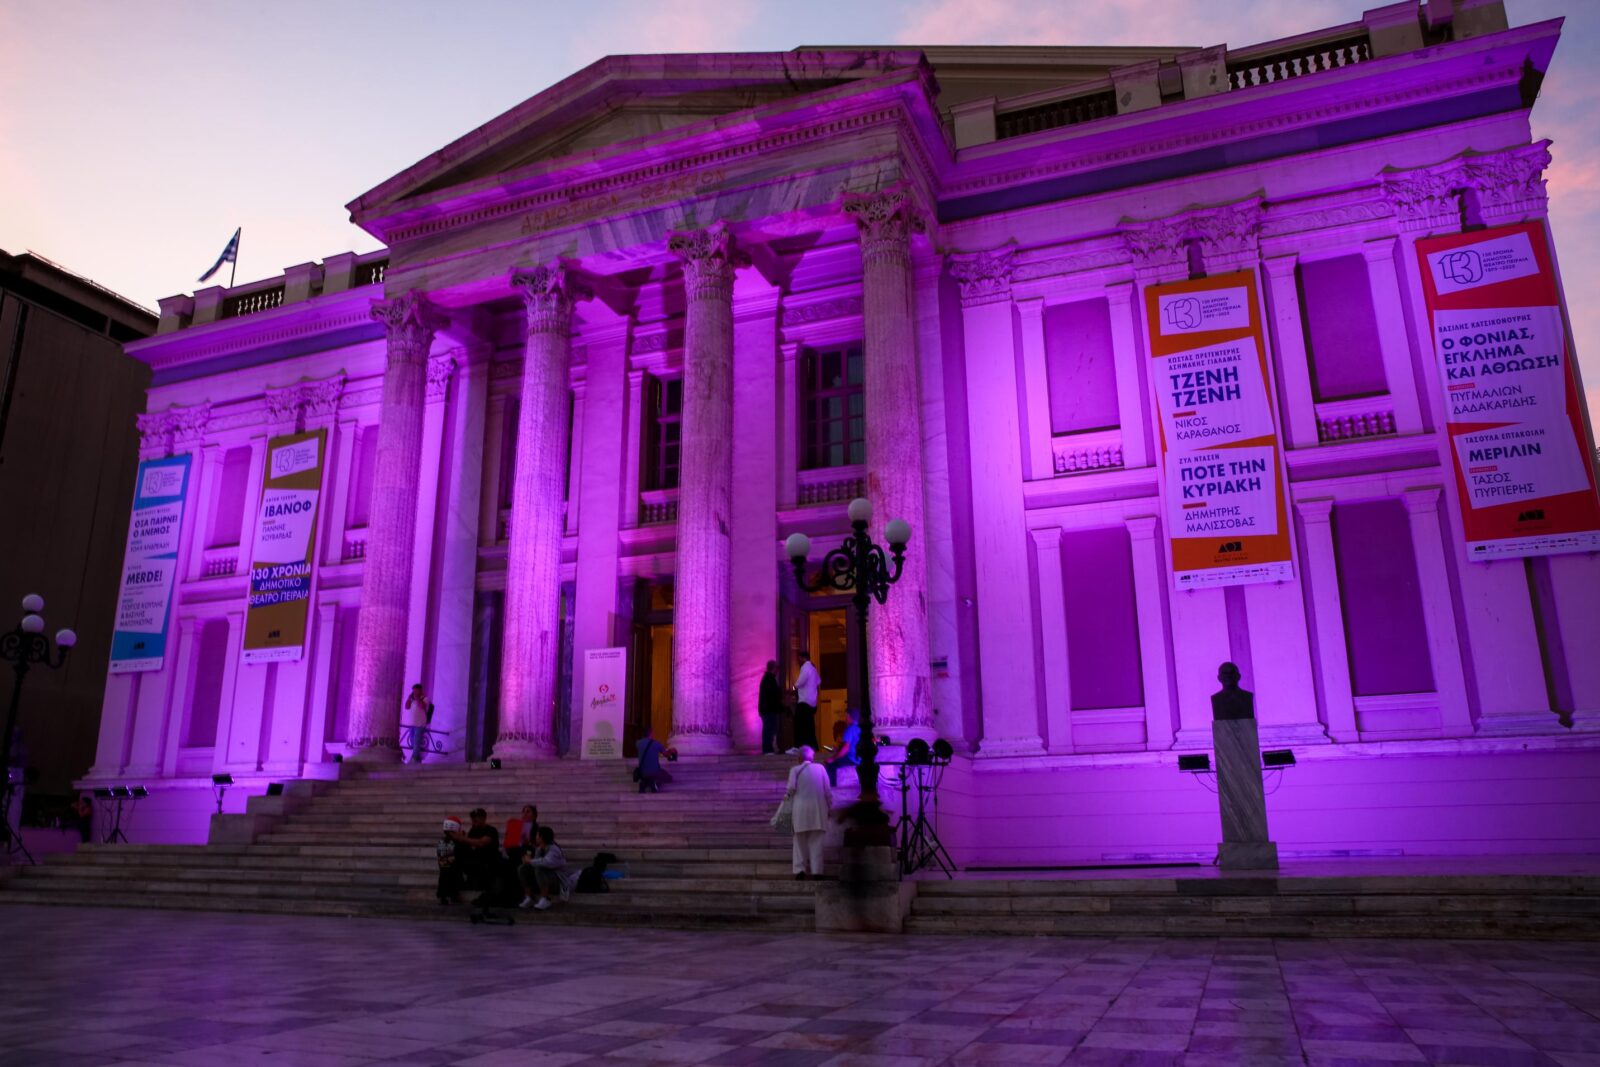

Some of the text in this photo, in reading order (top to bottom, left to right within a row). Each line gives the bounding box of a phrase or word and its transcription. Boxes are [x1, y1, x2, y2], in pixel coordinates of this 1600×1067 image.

[1438, 314, 1531, 333] ΒΑΣΙΛΗΣ ΚΑΤΣΙΚΟΝΟΥΡΗΣ
[1441, 328, 1535, 350] Ο ΦΟΝΙΑΣ,
[1168, 347, 1240, 364] ΚΩΣΤΑΣ ΠΡΕΤΕΝΤΕΡΗΣ
[1168, 354, 1241, 370] ΑΣΗΜΑΚΗΣ ΓΙΑΛΑΜΑΣ
[1444, 344, 1525, 365] ΕΓΚΛΗΜΑ
[1446, 354, 1560, 380] ΚΑΙ ΑΘΩΩΣΗ
[1170, 366, 1239, 390] ΤΖΕΝΗ
[1172, 383, 1241, 408] ΤΖΕΝΗ
[1450, 385, 1522, 402] ΠΥΓΜΑΛΙΩΝ
[1453, 395, 1537, 415] ΔΑΔΑΚΑΡΙΔΗΣ
[1175, 416, 1208, 429] ΝΙΚΟΣ
[1176, 424, 1241, 440] ΚΑΡΑΘΑΝΟΣ
[1465, 429, 1545, 444] ΤΑΣΟΥΛΑ ΕΠΤΑΚΟΙΛΗ
[1469, 442, 1542, 462] ΜΕΡΙΛΙΝ
[1181, 458, 1266, 481] ΠΟΤΕ ΤΗΝ
[1472, 472, 1512, 485] ΤΑΣΟΣ
[1182, 476, 1261, 499] ΚΥΡΙΑΚΗ
[1474, 482, 1536, 498] ΠΥΡΓΙΕΡΗΣ
[264, 500, 312, 518] ΙΒΑΝΟΦ
[1185, 506, 1241, 521] ΔΗΜΗΤΡΗΣ
[150, 514, 178, 526] ΠΑΙΡΝΕΙ
[1186, 516, 1256, 533] ΜΑΛΙΣΣΟΒΑΣ
[133, 525, 170, 538] Ο ΑΝΕΜΟΣ
[126, 570, 163, 585] MERDE!
[252, 562, 311, 581] 130 ΧΡΟΝΙΑ
[259, 576, 302, 591] ΔΗΜΟΤΙΚΟ
[249, 588, 309, 605] ΘΕΑΤΡΟ ΠΕΙΡΑΙΑ
